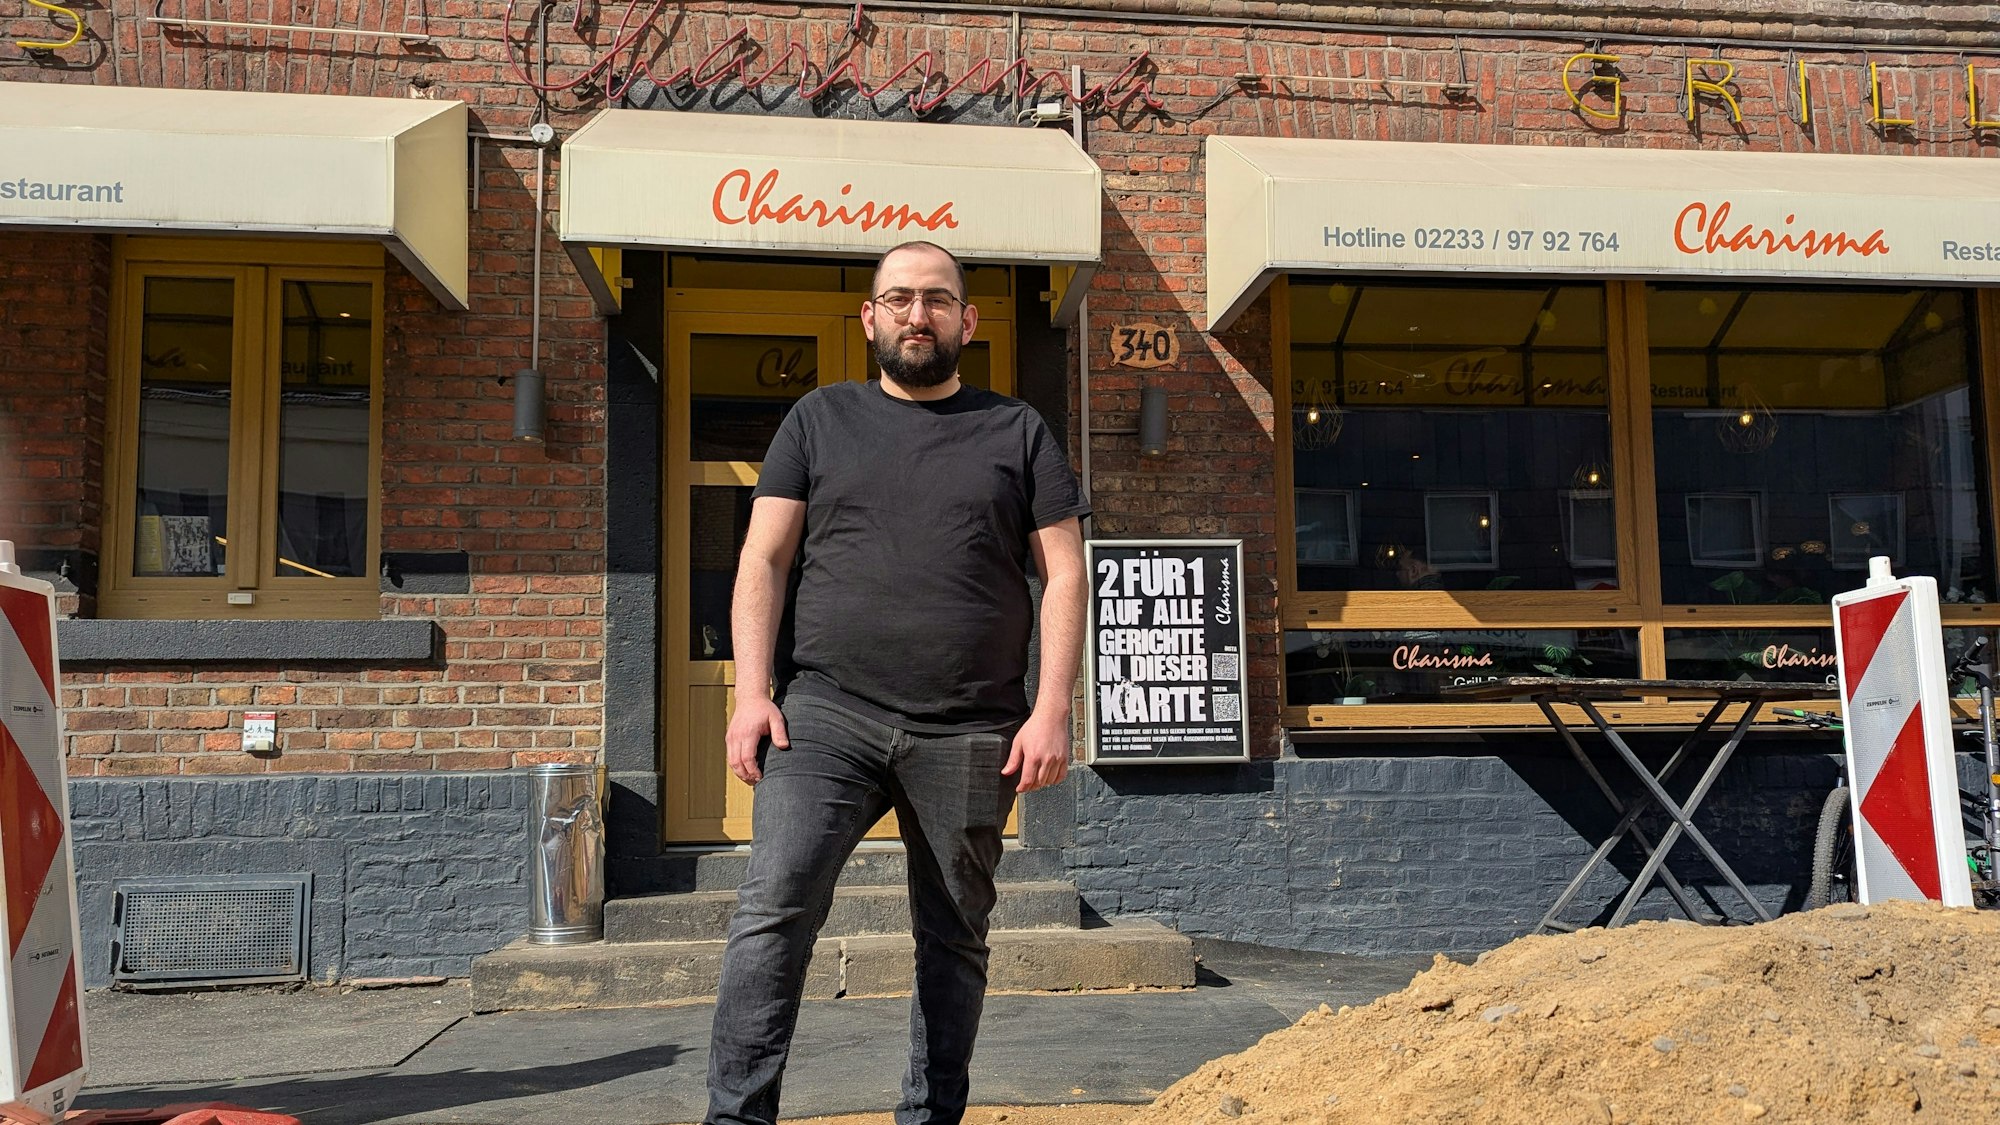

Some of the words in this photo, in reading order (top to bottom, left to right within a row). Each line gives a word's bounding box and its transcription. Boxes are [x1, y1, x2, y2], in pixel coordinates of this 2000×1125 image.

[1562, 53, 2000, 129] GRILL
[0, 178, 124, 203] staurant
[712, 168, 959, 232] Charisma
[1323, 226, 1406, 248] Hotline
[1414, 228, 1485, 250] 02233
[1492, 229, 1500, 250] /
[1507, 230, 1534, 251] 97
[1542, 231, 1570, 252] 92
[1578, 231, 1620, 252] 764
[1674, 201, 1890, 259] Charisma
[1119, 328, 1170, 361] 340
[1097, 559, 1119, 597] 2
[1123, 550, 1187, 597] FÜR
[1187, 557, 1204, 595] 1
[1215, 558, 1232, 625] Charisma
[1099, 599, 1143, 626] AUF
[1152, 598, 1205, 626] ALLE
[1099, 628, 1205, 656] GERICHTE
[1392, 644, 1493, 670] Charisma
[1098, 655, 1122, 682] IN
[1130, 654, 1208, 681] DIESER
[1100, 683, 1207, 724] KARTE
